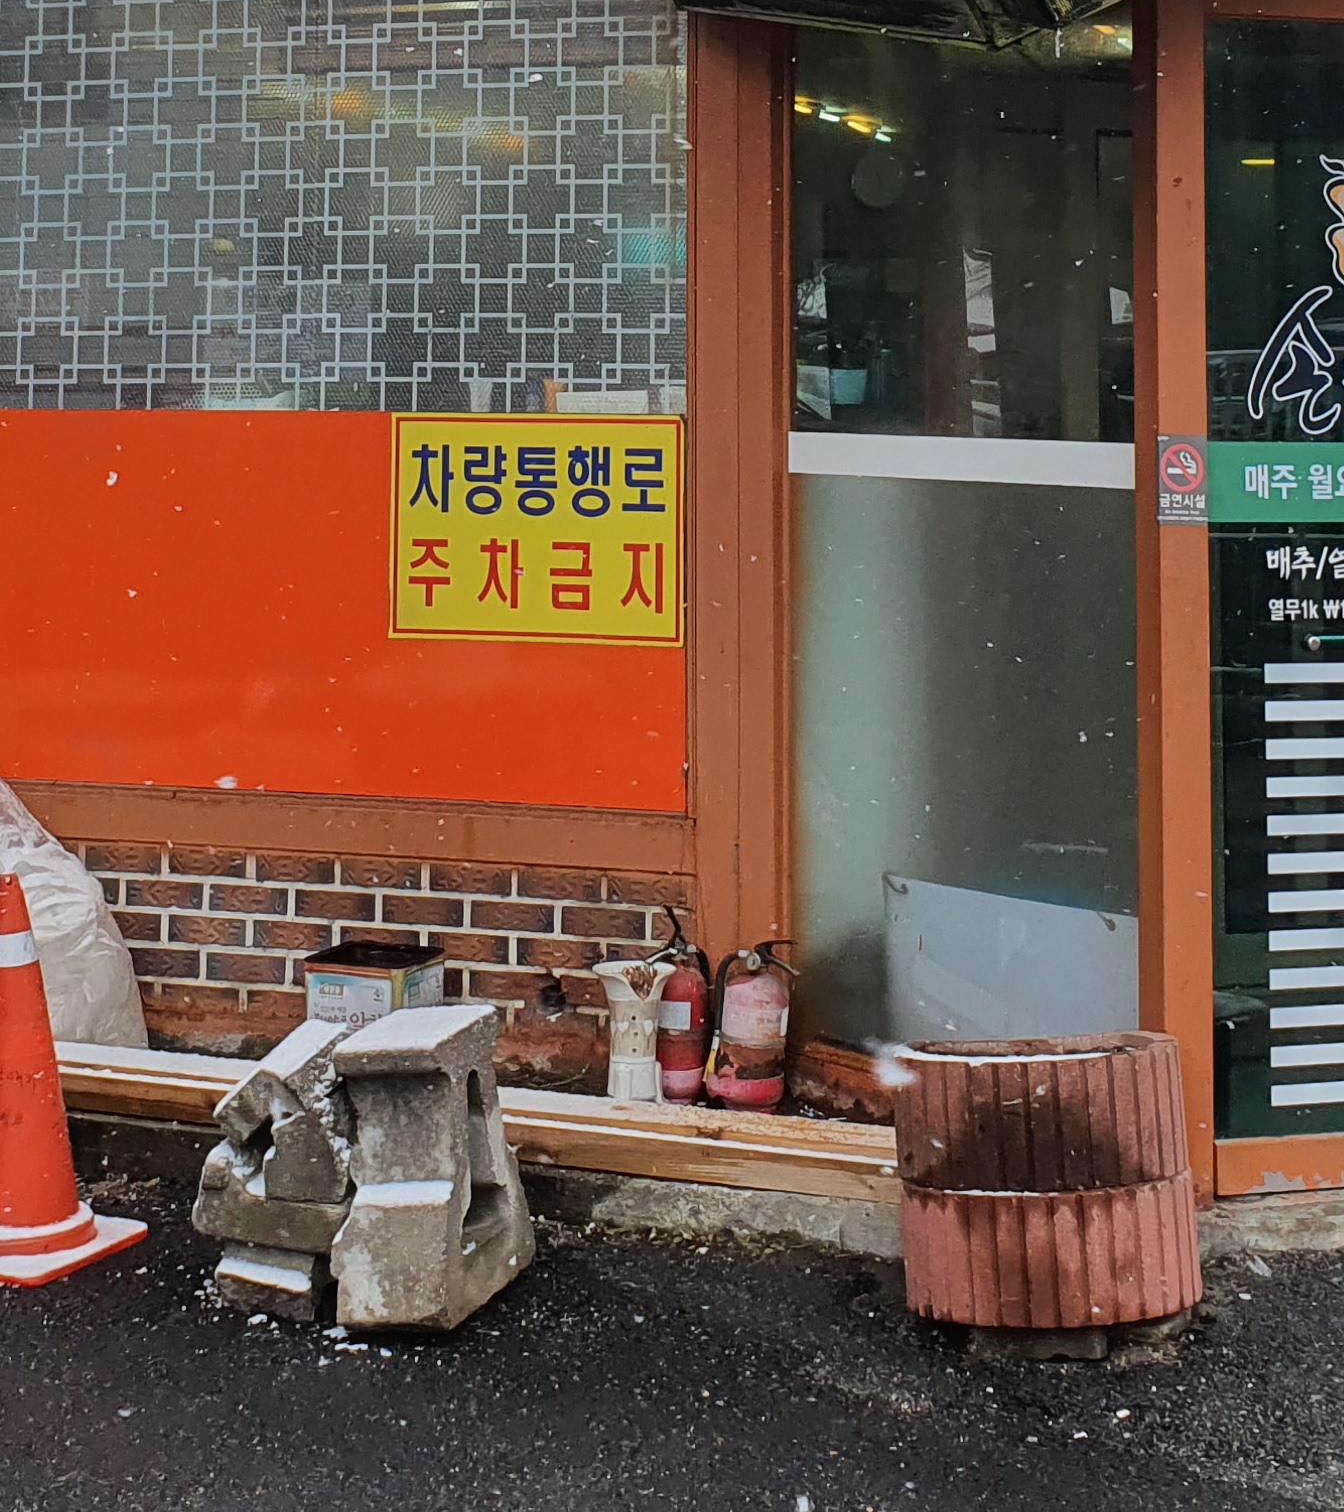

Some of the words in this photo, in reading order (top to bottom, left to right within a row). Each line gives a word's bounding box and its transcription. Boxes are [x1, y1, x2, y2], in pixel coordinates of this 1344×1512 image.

[408, 444, 666, 518] 차량통행로
[1159, 493, 1206, 509] 금연시설
[1244, 464, 1299, 500] 매주
[408, 538, 664, 615] 주차금지
